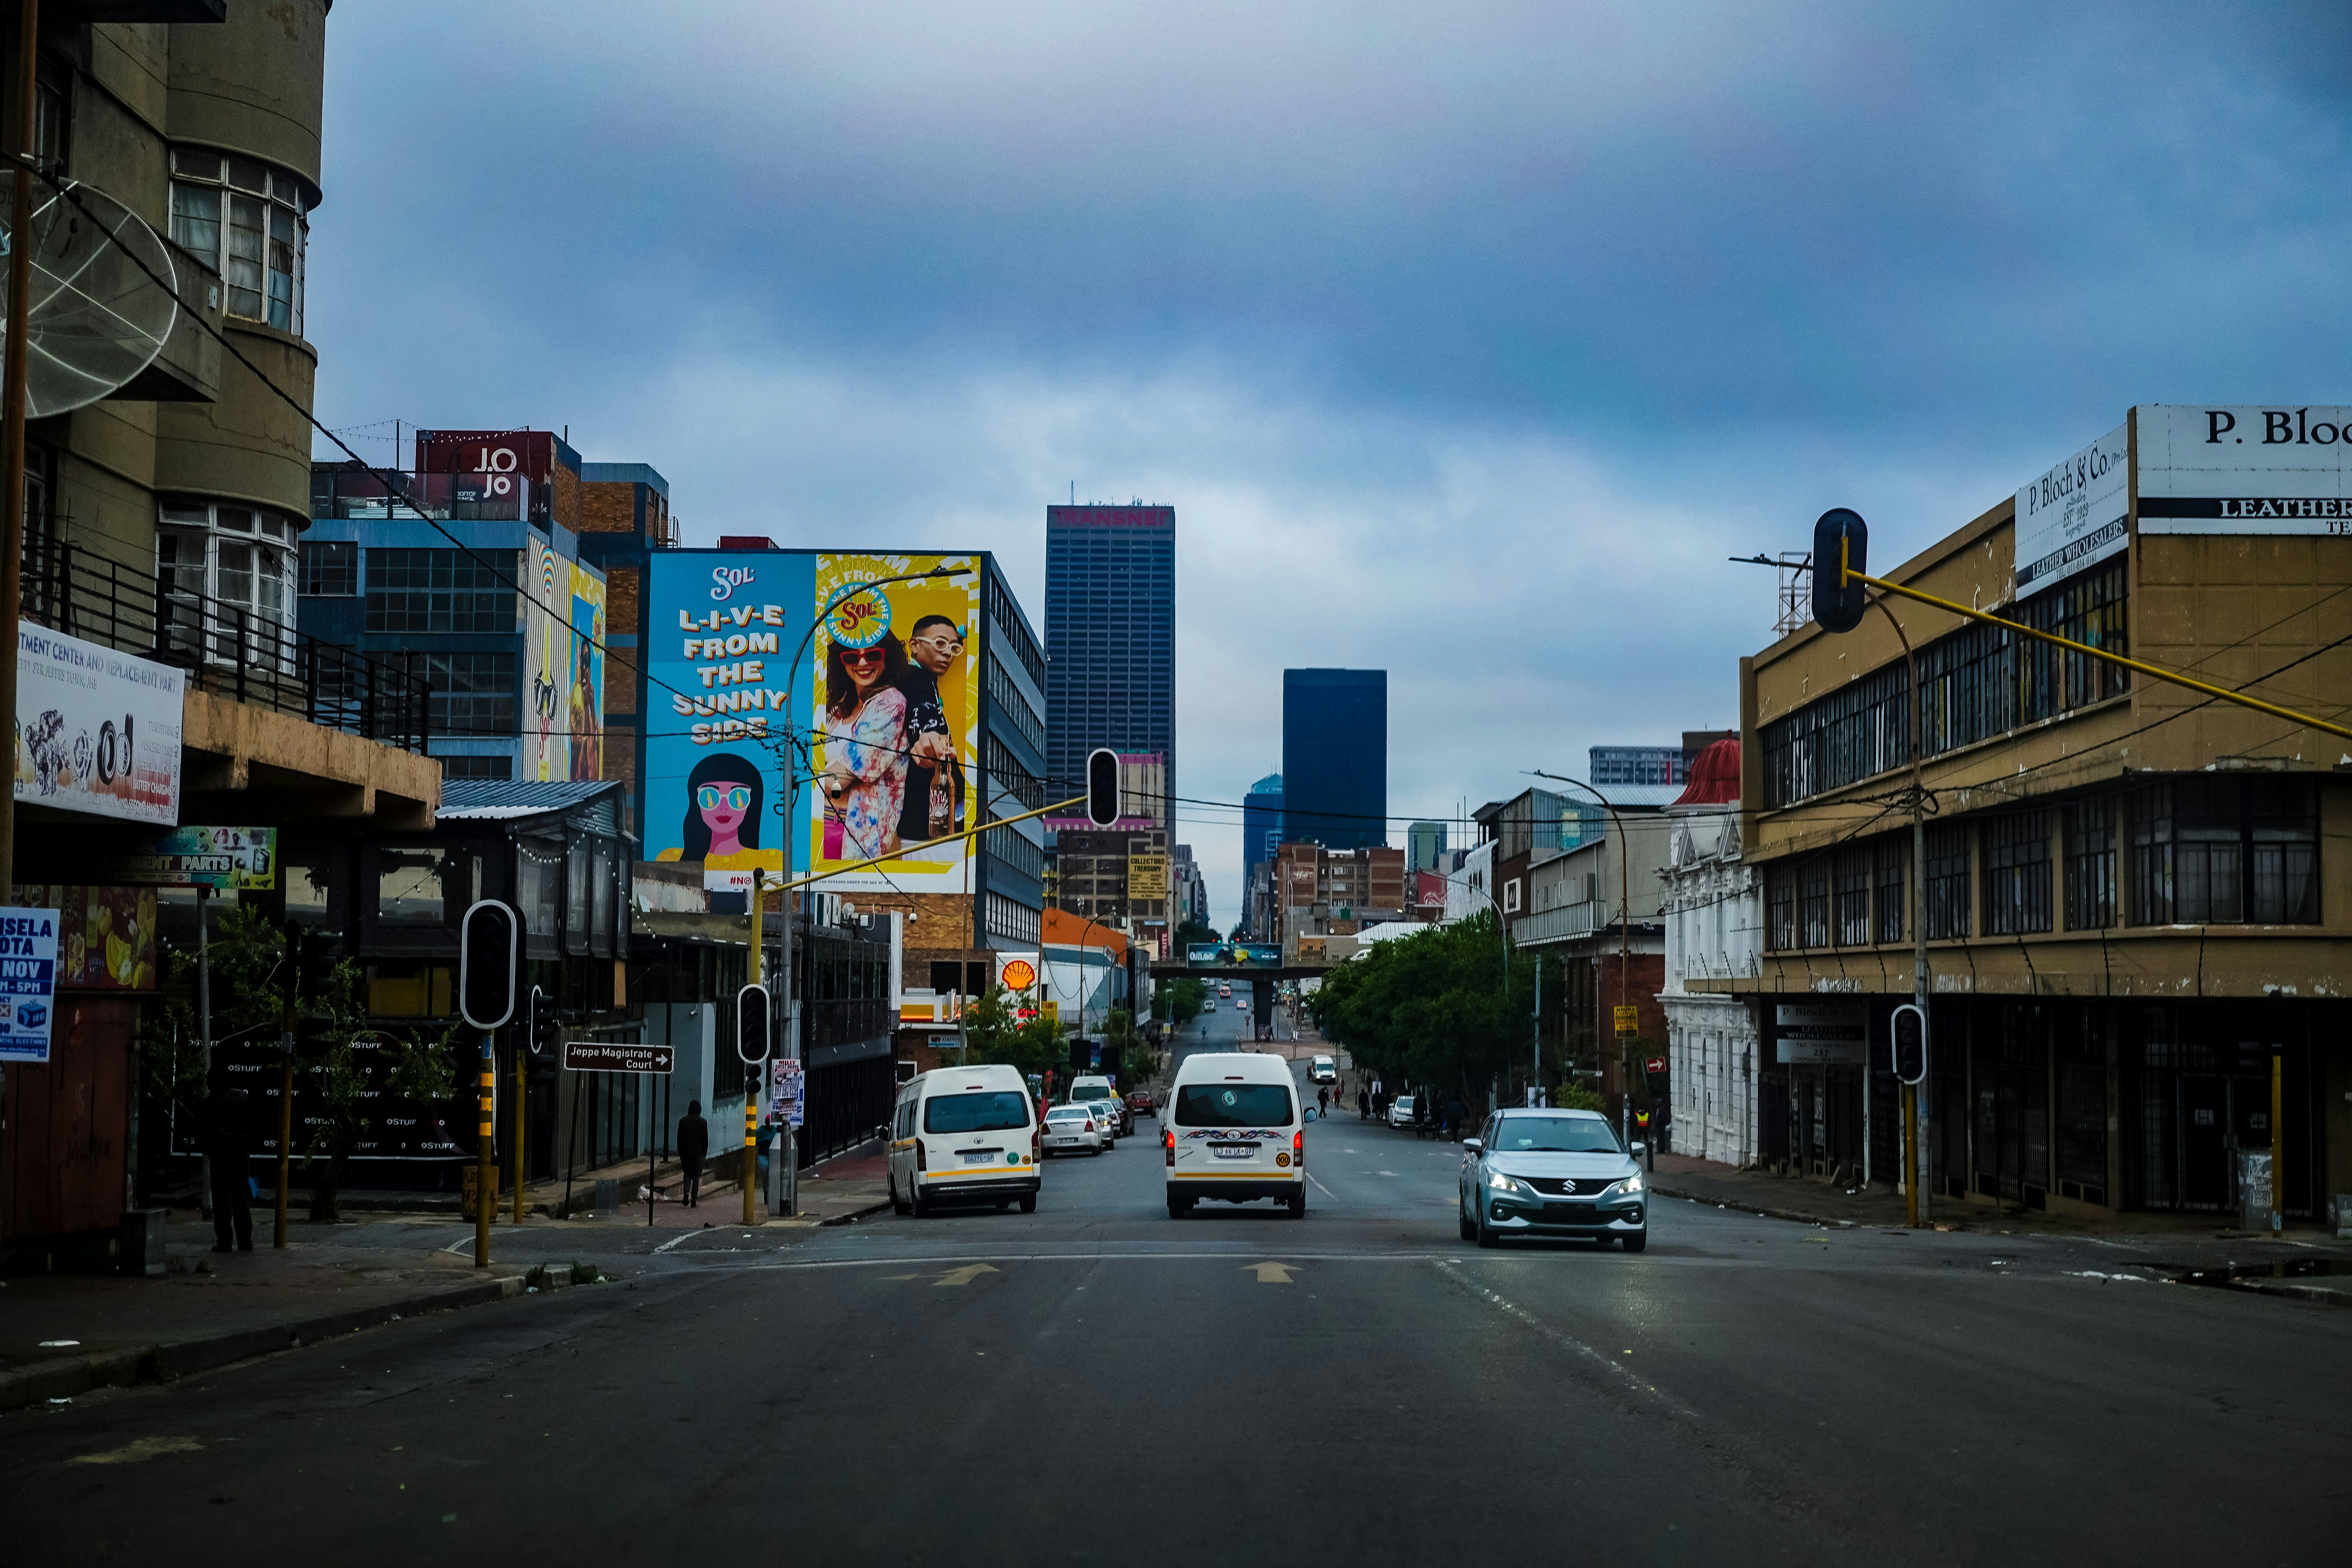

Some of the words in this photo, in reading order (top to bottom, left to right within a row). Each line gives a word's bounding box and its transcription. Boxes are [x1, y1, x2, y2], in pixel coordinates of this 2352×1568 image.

[2204, 411, 2243, 444] P.
[2029, 485, 2039, 516] P.
[2042, 460, 2073, 508] Bloch
[2077, 455, 2087, 491] &
[2090, 446, 2111, 479] Co.
[1053, 510, 1169, 526] TRANSNET
[2220, 499, 2352, 517] LEATHER
[2033, 552, 2063, 580] LEATHER
[2065, 519, 2123, 562] WHOLESALERS
[679, 604, 785, 632] L-I-V-E
[684, 632, 779, 660] FROM
[829, 622, 863, 646] SUNNY
[865, 622, 887, 644] SIDE
[53, 642, 84, 667] CENTER
[697, 661, 764, 689] THE
[672, 688, 787, 717] SUNNY
[690, 717, 768, 746] SIDE
[133, 779, 151, 793] BATTERY
[181, 856, 231, 871] PARTS
[2, 960, 40, 978] NOV
[1796, 1007, 1825, 1016] Bloch
[571, 1047, 599, 1058] Jeppe
[602, 1048, 652, 1059] Magistrate
[626, 1060, 652, 1069] Court
